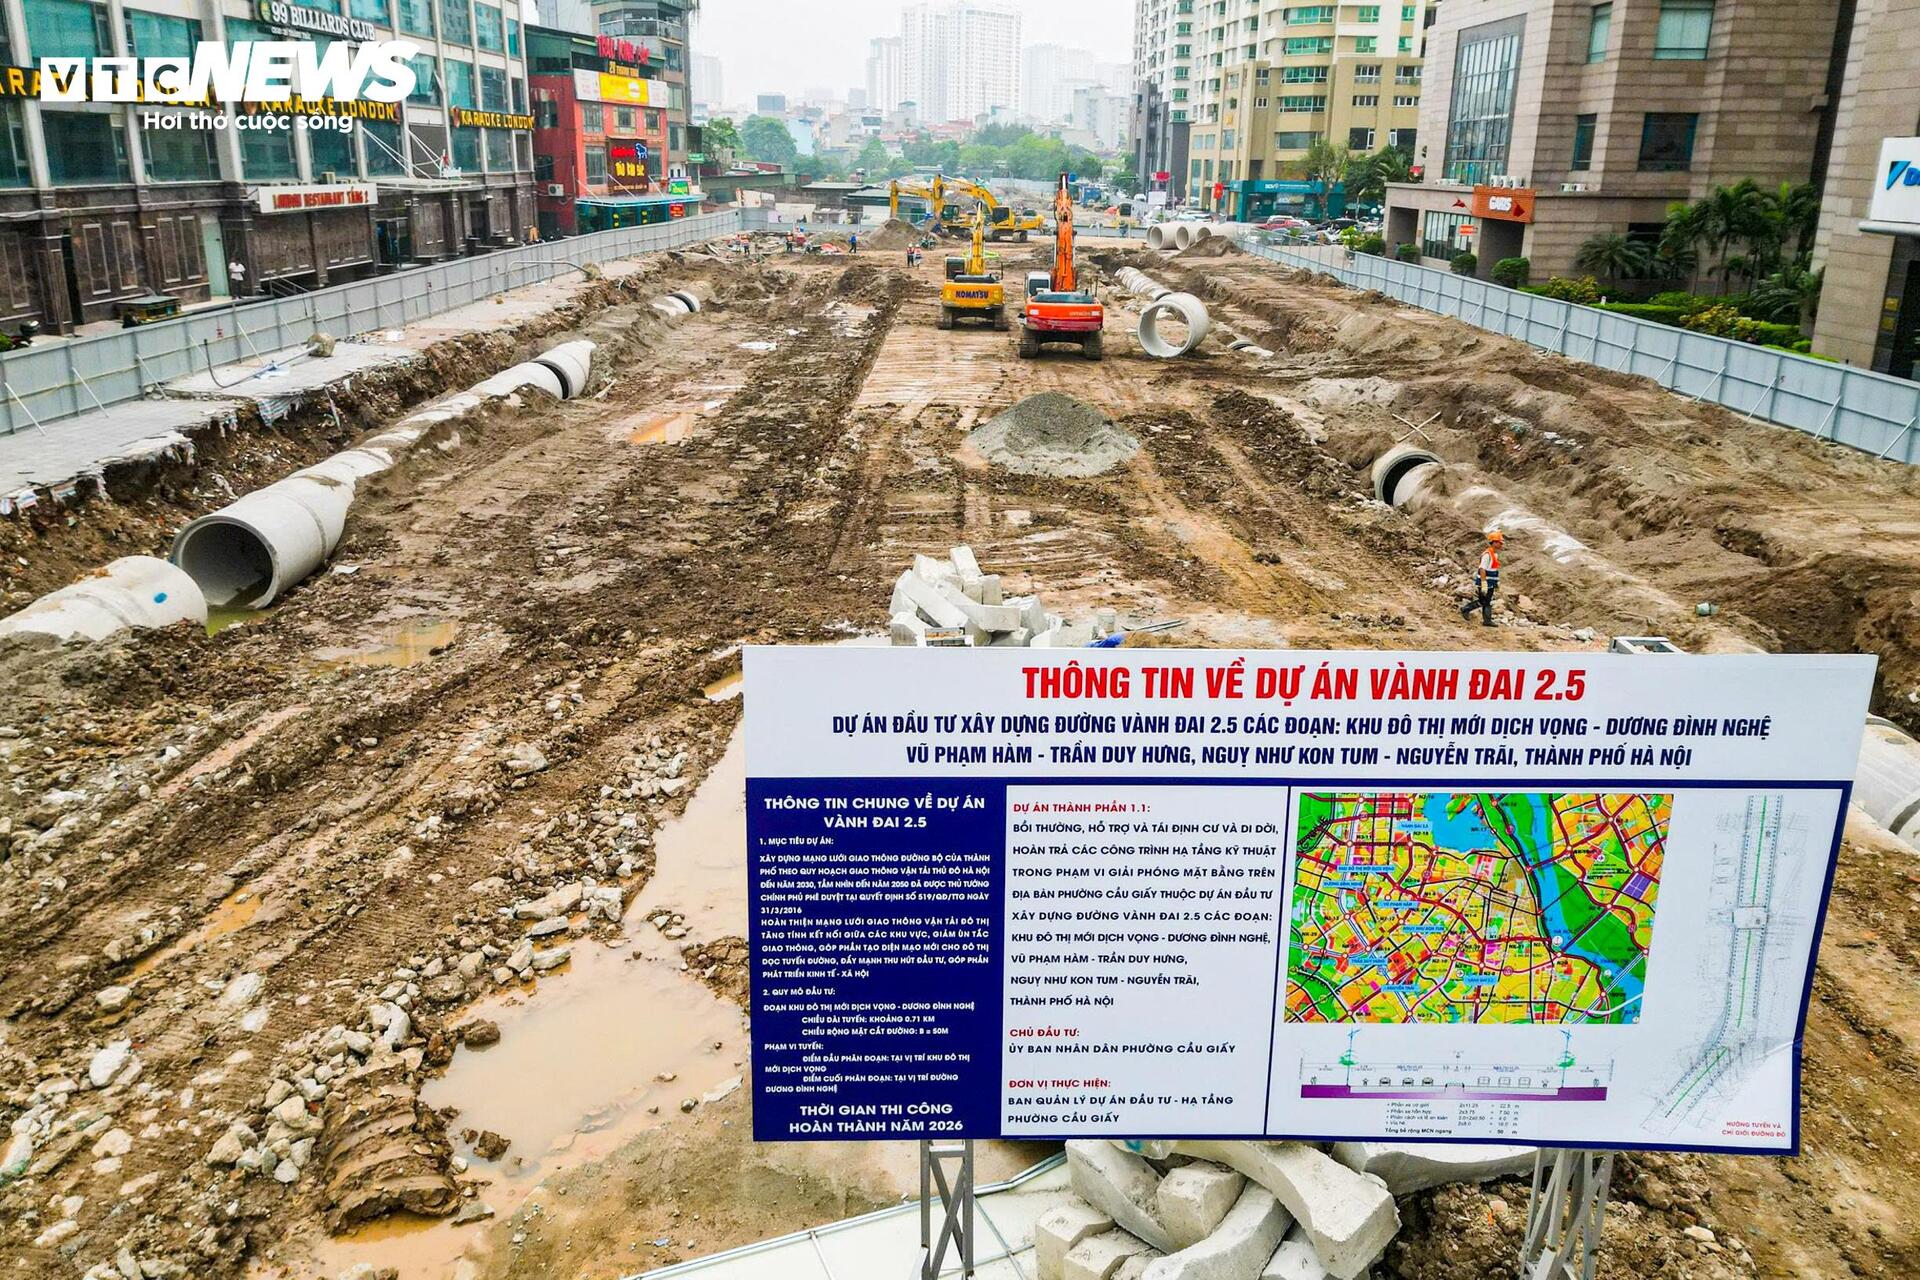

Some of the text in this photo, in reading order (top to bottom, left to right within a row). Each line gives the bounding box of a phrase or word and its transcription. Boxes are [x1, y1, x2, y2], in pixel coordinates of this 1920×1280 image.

[271, 2, 289, 23] 99
[291, 7, 349, 36] BILLIARDS
[350, 19, 375, 40] CLUB
[341, 101, 395, 120] LONDON
[461, 110, 535, 129] KARAOKE LONDON
[955, 291, 988, 299] KOMATSU
[1022, 657, 1585, 706] THÔNG TIN VỀ DỰ ÁN VÀNH ĐAI 2.5
[833, 715, 858, 737] DỰ
[862, 712, 886, 733] ÁN
[892, 712, 928, 733] ĐẦU
[934, 714, 957, 733] TƯ
[961, 712, 995, 733] XÂY
[1002, 714, 1049, 737] DỰNG
[1055, 713, 1115, 733] ĐƯỜNG
[1122, 713, 1169, 733] VÀNH
[1175, 716, 1204, 733] ĐAI
[1210, 717, 1237, 733] 2.5
[1244, 713, 1279, 734] CÁC
[1285, 717, 1340, 738] ĐOẠN:
[1346, 718, 1382, 734] KHU
[1388, 714, 1411, 734] ĐÔ
[1418, 718, 1445, 738] THỊ
[1451, 714, 1485, 734] MỚI
[1491, 718, 1533, 738] DỊCH
[1540, 718, 1587, 739] VỌNG
[1606, 717, 1668, 735] DƯƠNG
[1673, 715, 1717, 736] ĐÌNH
[1722, 716, 1771, 740] NGHỆ
[907, 743, 928, 763] VŨ
[935, 746, 986, 766] PHẠM
[993, 743, 1032, 763] HÀM
[1050, 742, 1096, 762] TRẦN
[1102, 746, 1136, 763] DUY
[1142, 745, 1195, 765] HƯNG,
[1202, 746, 1249, 767] NGUỴ
[1256, 746, 1295, 764] NHƯ
[1299, 748, 1334, 764] KON
[1341, 748, 1378, 764] TUM
[1397, 742, 1468, 764] NGUYỄN
[1475, 745, 1517, 767] TRÃI,
[1525, 745, 1583, 765] THÀNH
[1589, 742, 1627, 765] PHỐ
[1630, 745, 1653, 765] HÀ
[1660, 745, 1692, 769] NỘI
[764, 792, 985, 812] THÔNG TIN CHUNG VỀ DỰ ÁN
[1013, 799, 1151, 815] DỰ ÁN THÀNH PHẦN 1.1:
[824, 814, 927, 828] VÀNH ĐAI 2.5
[1013, 819, 1279, 835] BỒI THƯỜNG, HỖ TRỢ VÀ TÁI ĐỊNH CƯ VÀ DI DỜI,
[1009, 1025, 1080, 1037] CHỦ ĐẦU TƯ:
[1008, 1041, 1236, 1054] ỦY BAN NHÂN DÂN PHƯỜNG CẦU GIẤY
[1008, 1077, 1111, 1090] ĐƠN VỊ THỰC HIỆN:
[1007, 1097, 1033, 1106] BAN
[1035, 1094, 1070, 1105] QUẢN
[1073, 1094, 1087, 1105] LÝ
[1089, 1095, 1107, 1107] DỰ
[1109, 1094, 1126, 1105] ÁN
[1129, 1093, 1155, 1105] ĐẦU
[1157, 1095, 1172, 1105] TƯ
[1181, 1096, 1198, 1107] HẠ
[1201, 1093, 1234, 1105] TẦNG
[800, 1103, 953, 1116] THỜI GIAN THI CÔNG
[1007, 1111, 1120, 1124] PHƯỜNG CẦU GIẤY
[790, 1120, 964, 1133] HOÀN THÀNH NĂM 2026
